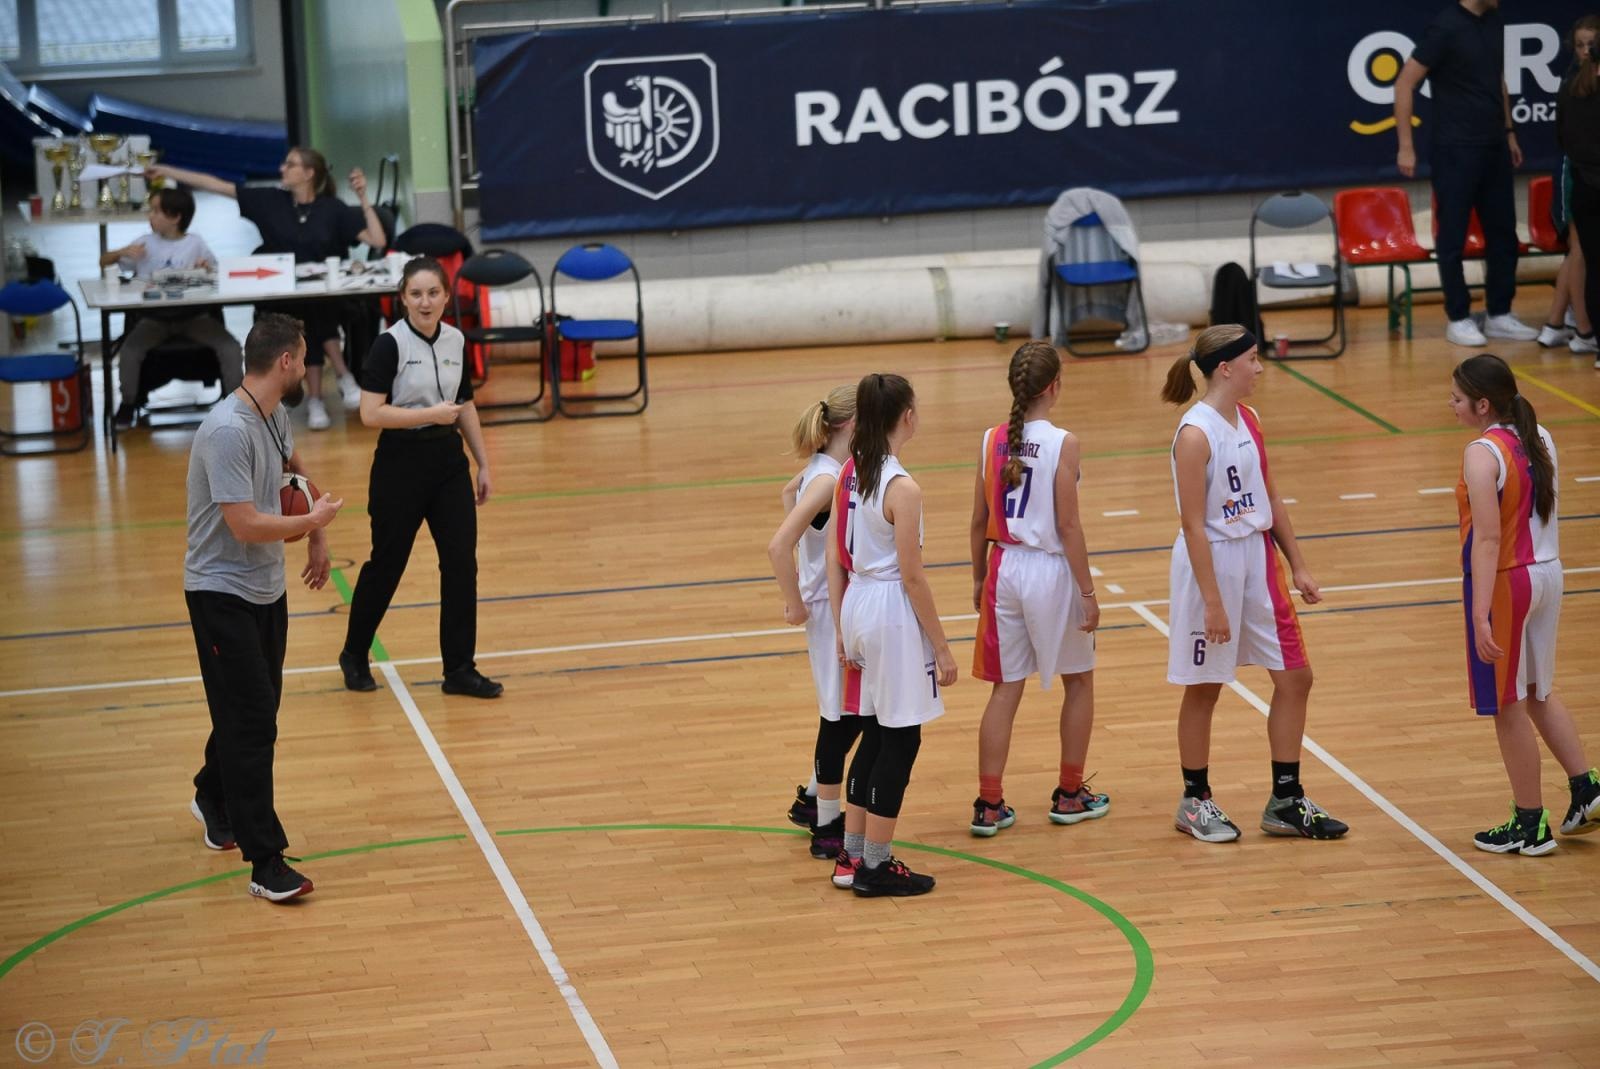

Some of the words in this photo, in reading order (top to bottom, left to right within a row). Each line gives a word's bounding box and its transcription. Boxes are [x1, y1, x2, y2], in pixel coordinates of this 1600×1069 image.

[795, 56, 1180, 147] RACIBÓRZ
[1226, 465, 1242, 493] 6
[1193, 639, 1206, 666] 6
